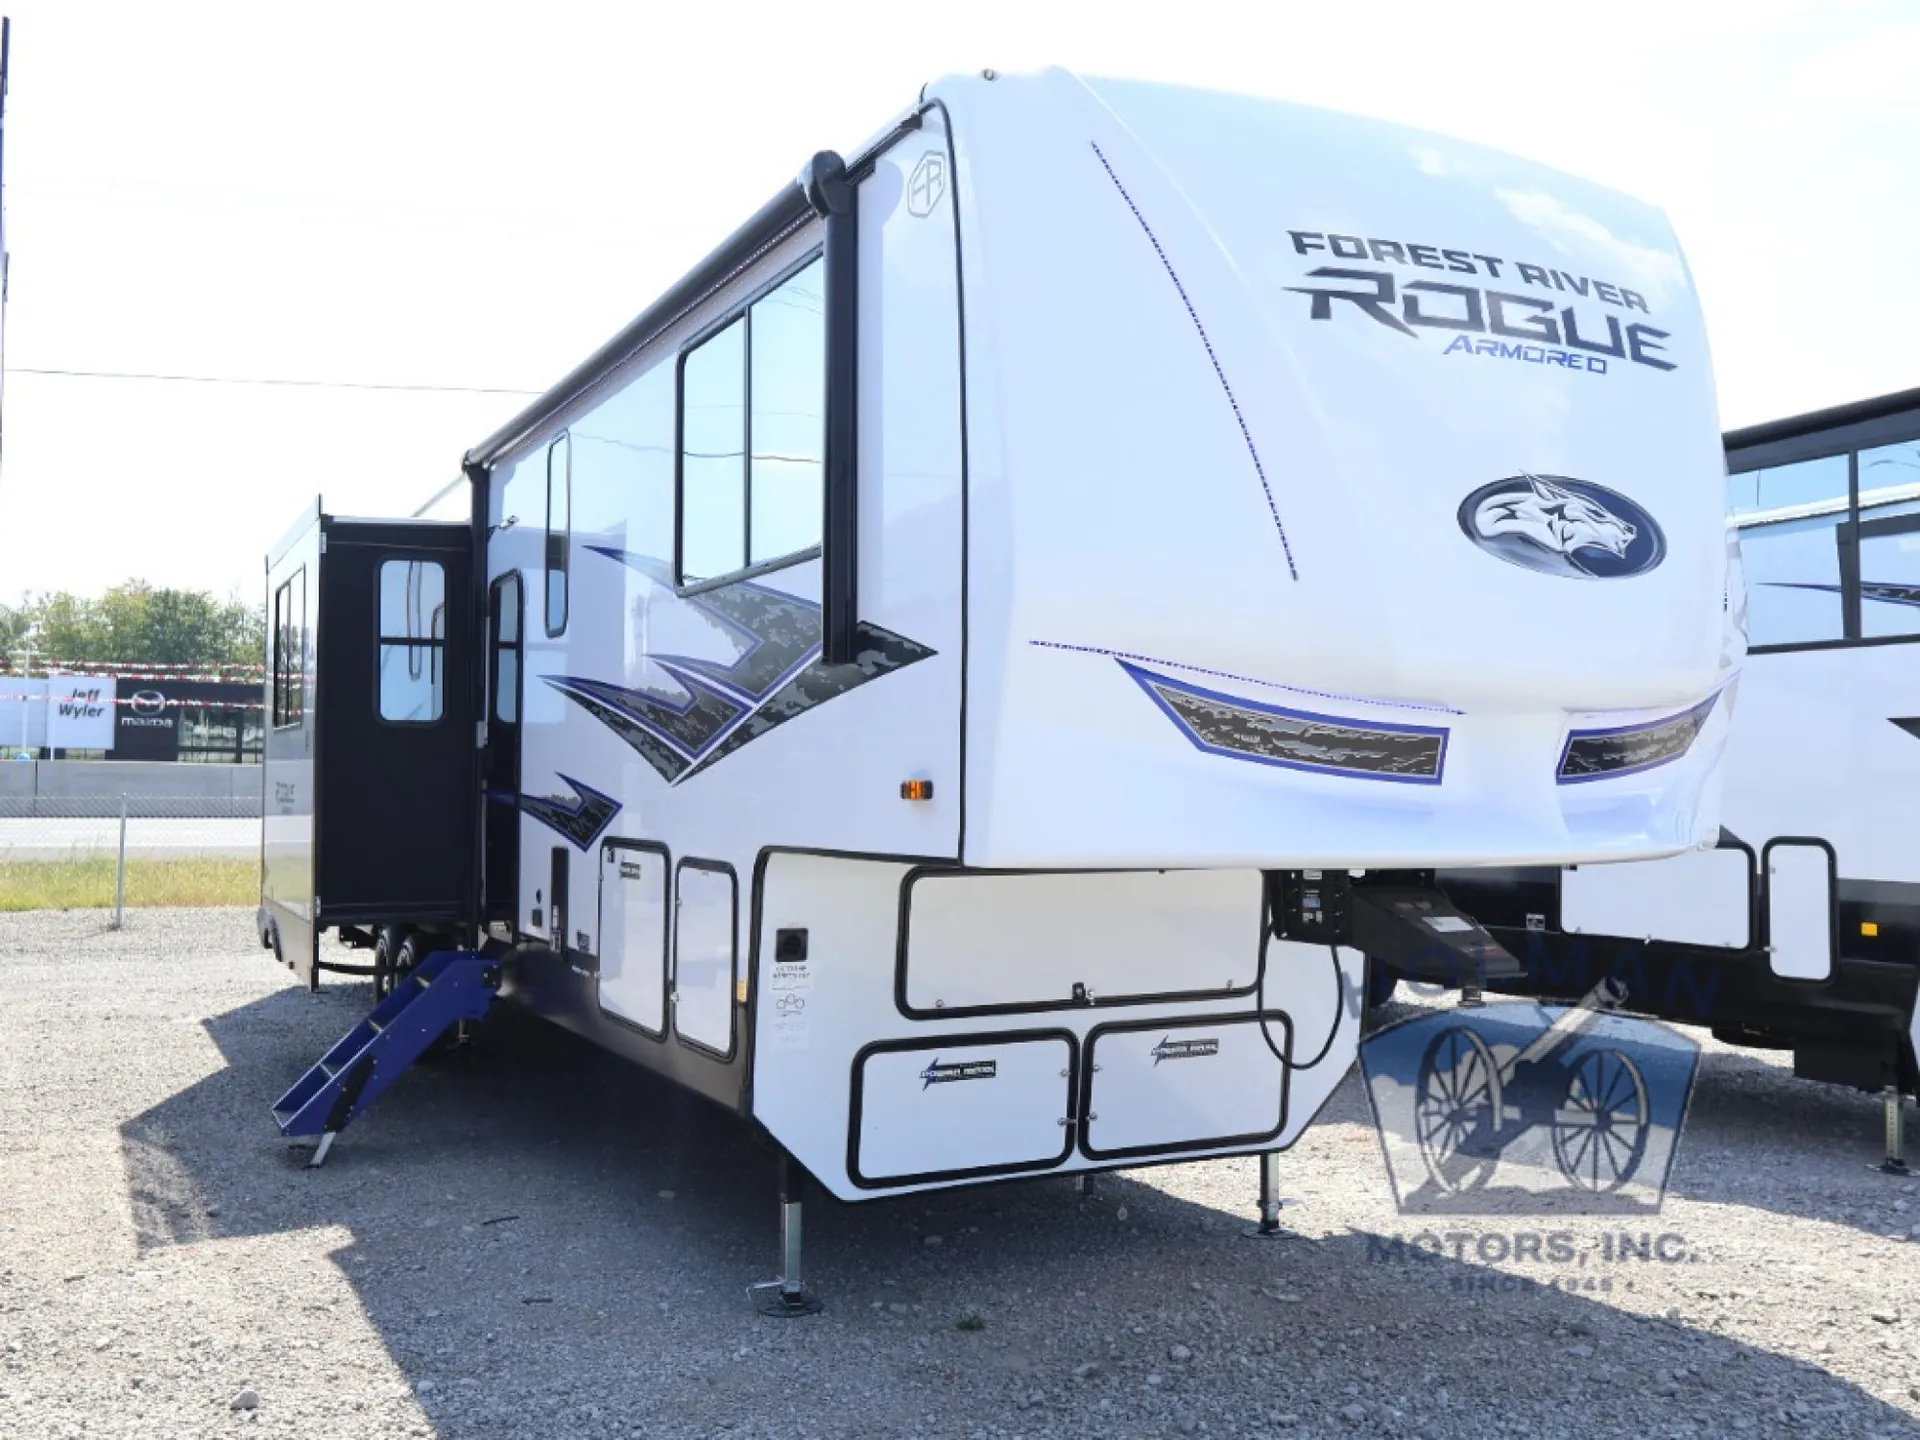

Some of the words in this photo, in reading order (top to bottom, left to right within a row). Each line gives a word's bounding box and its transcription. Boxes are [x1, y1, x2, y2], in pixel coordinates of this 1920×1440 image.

[1286, 230, 1503, 278] FOREST
[1515, 261, 1650, 314] RIVER
[1281, 266, 1679, 372] ROGUE
[1443, 335, 1608, 375] ARMORED
[58, 703, 105, 719] Wyler
